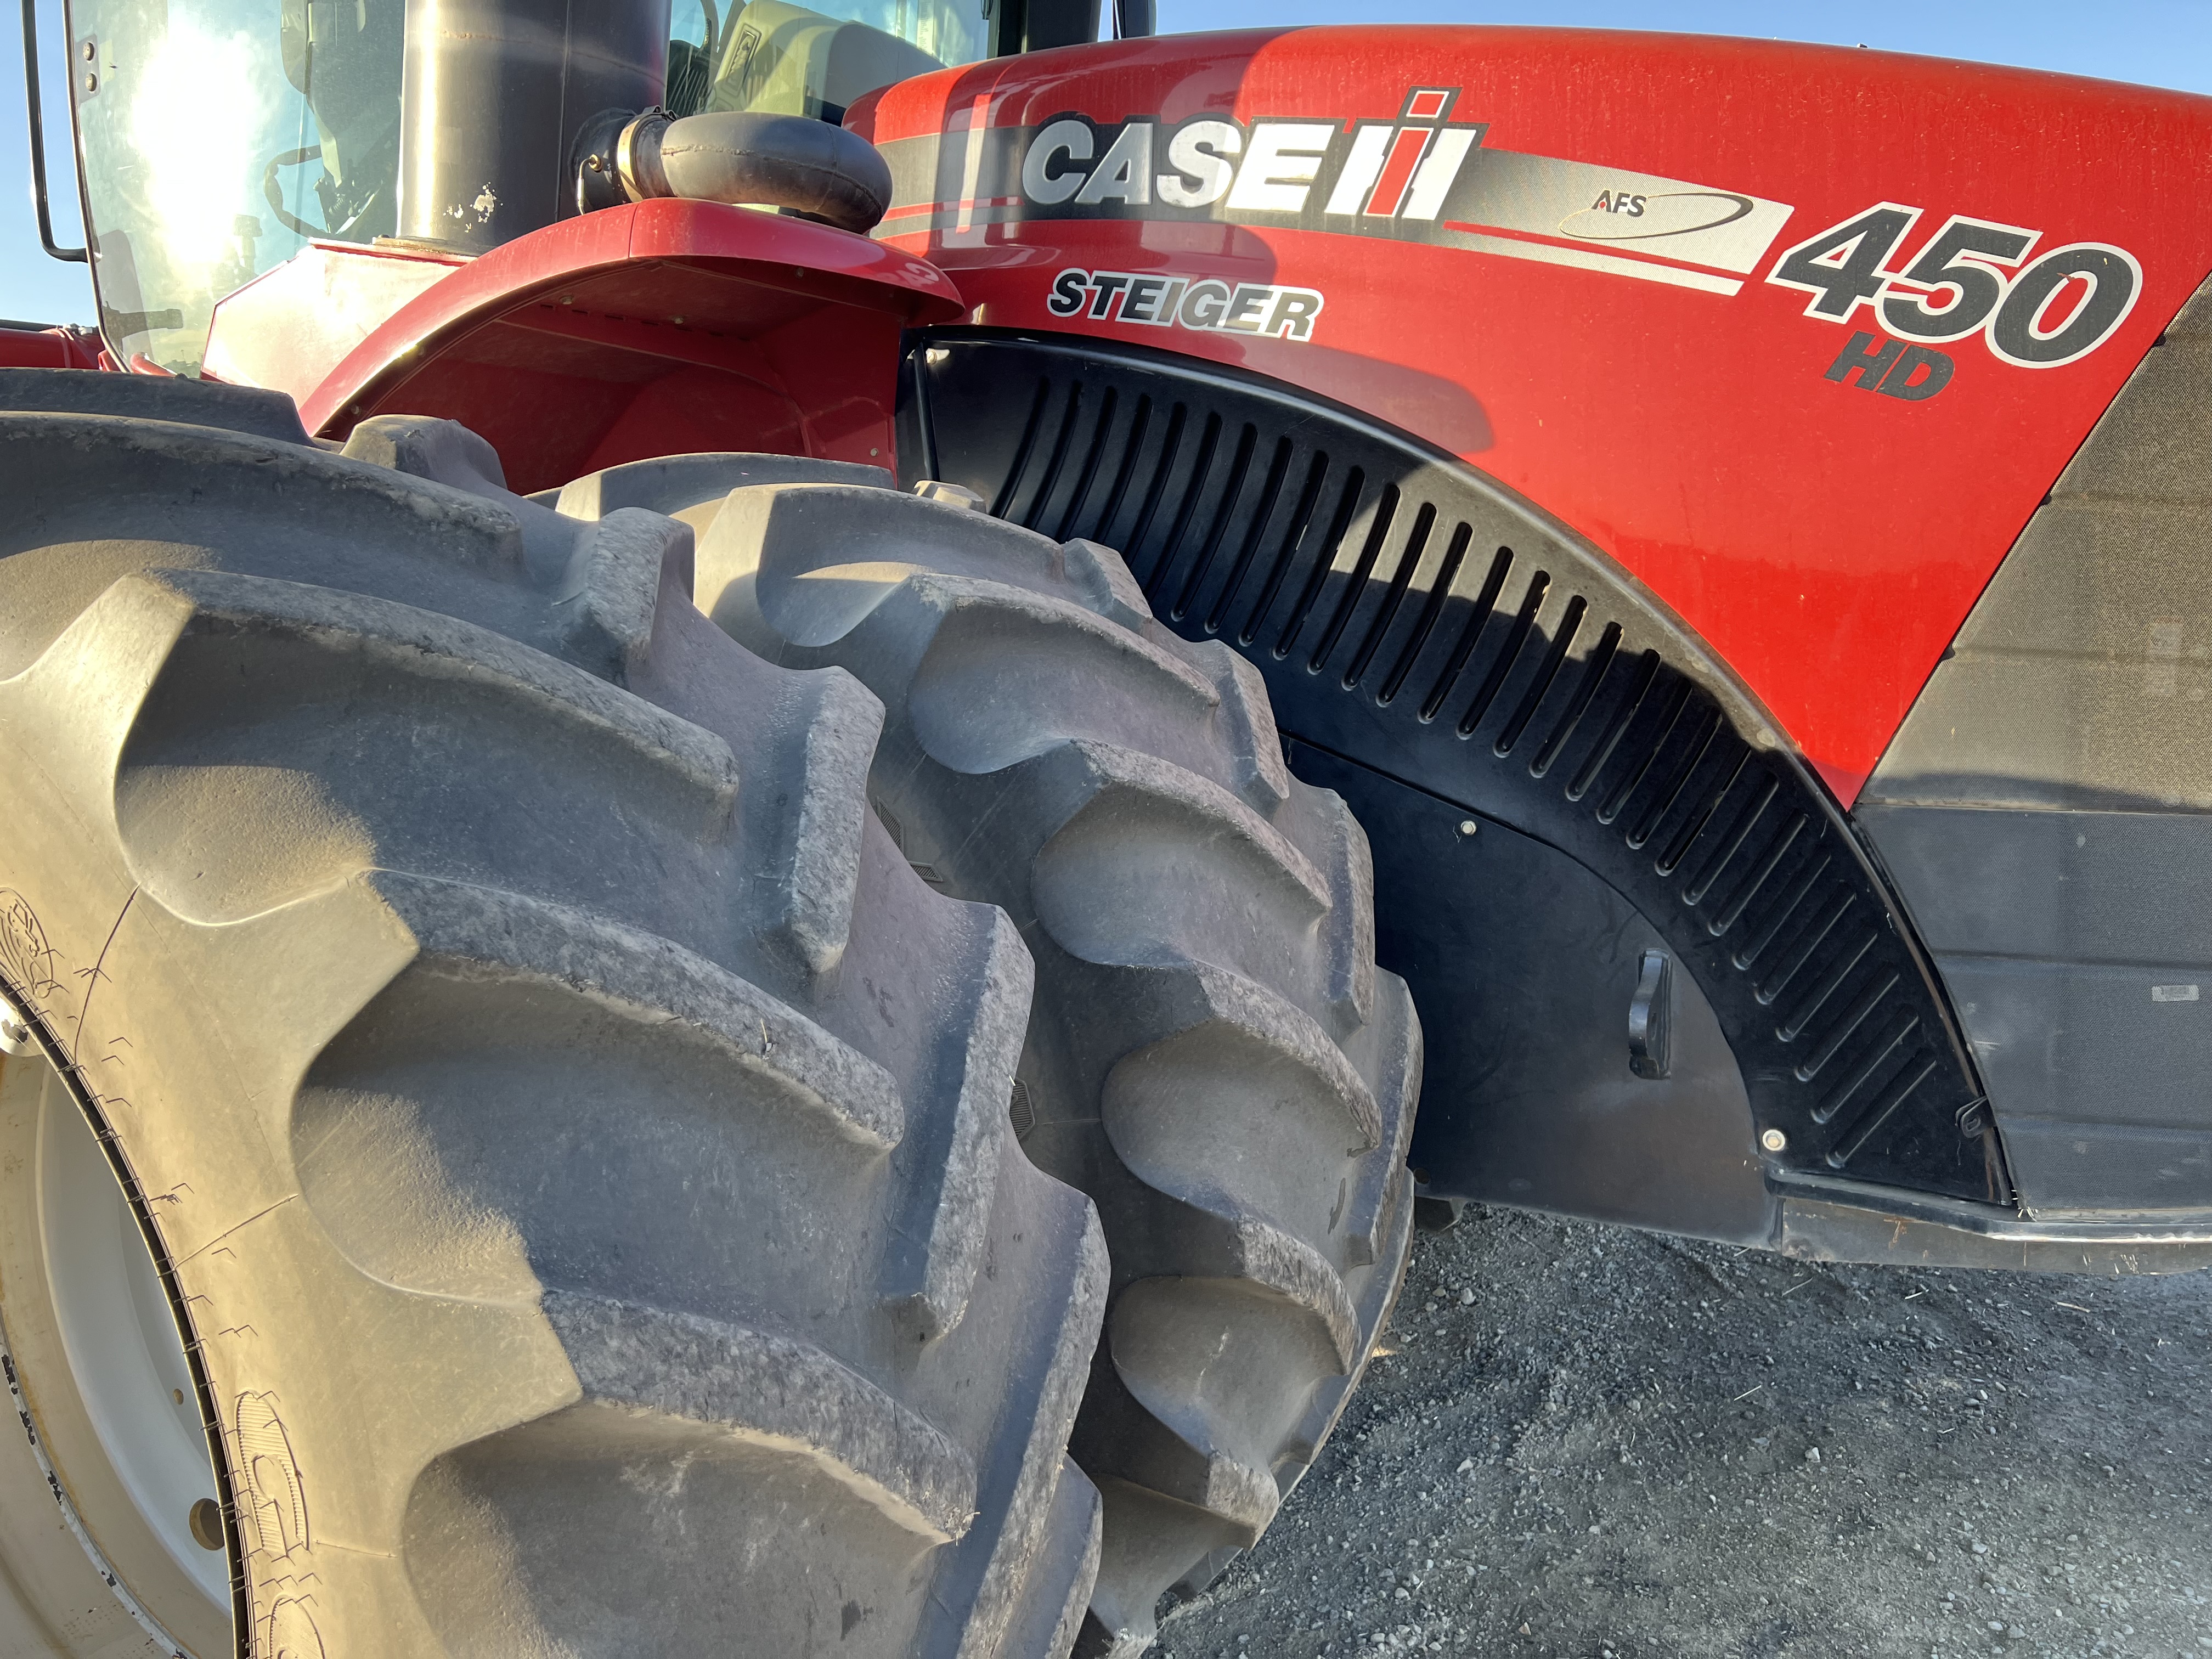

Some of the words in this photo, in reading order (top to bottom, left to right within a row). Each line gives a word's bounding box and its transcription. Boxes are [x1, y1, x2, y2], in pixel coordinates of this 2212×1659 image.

[1022, 120, 1335, 213] CASE
[1591, 190, 1647, 217] AFS
[1047, 268, 1324, 341] STEIGER
[1764, 201, 2143, 369] 450
[1823, 330, 1955, 401] HD
